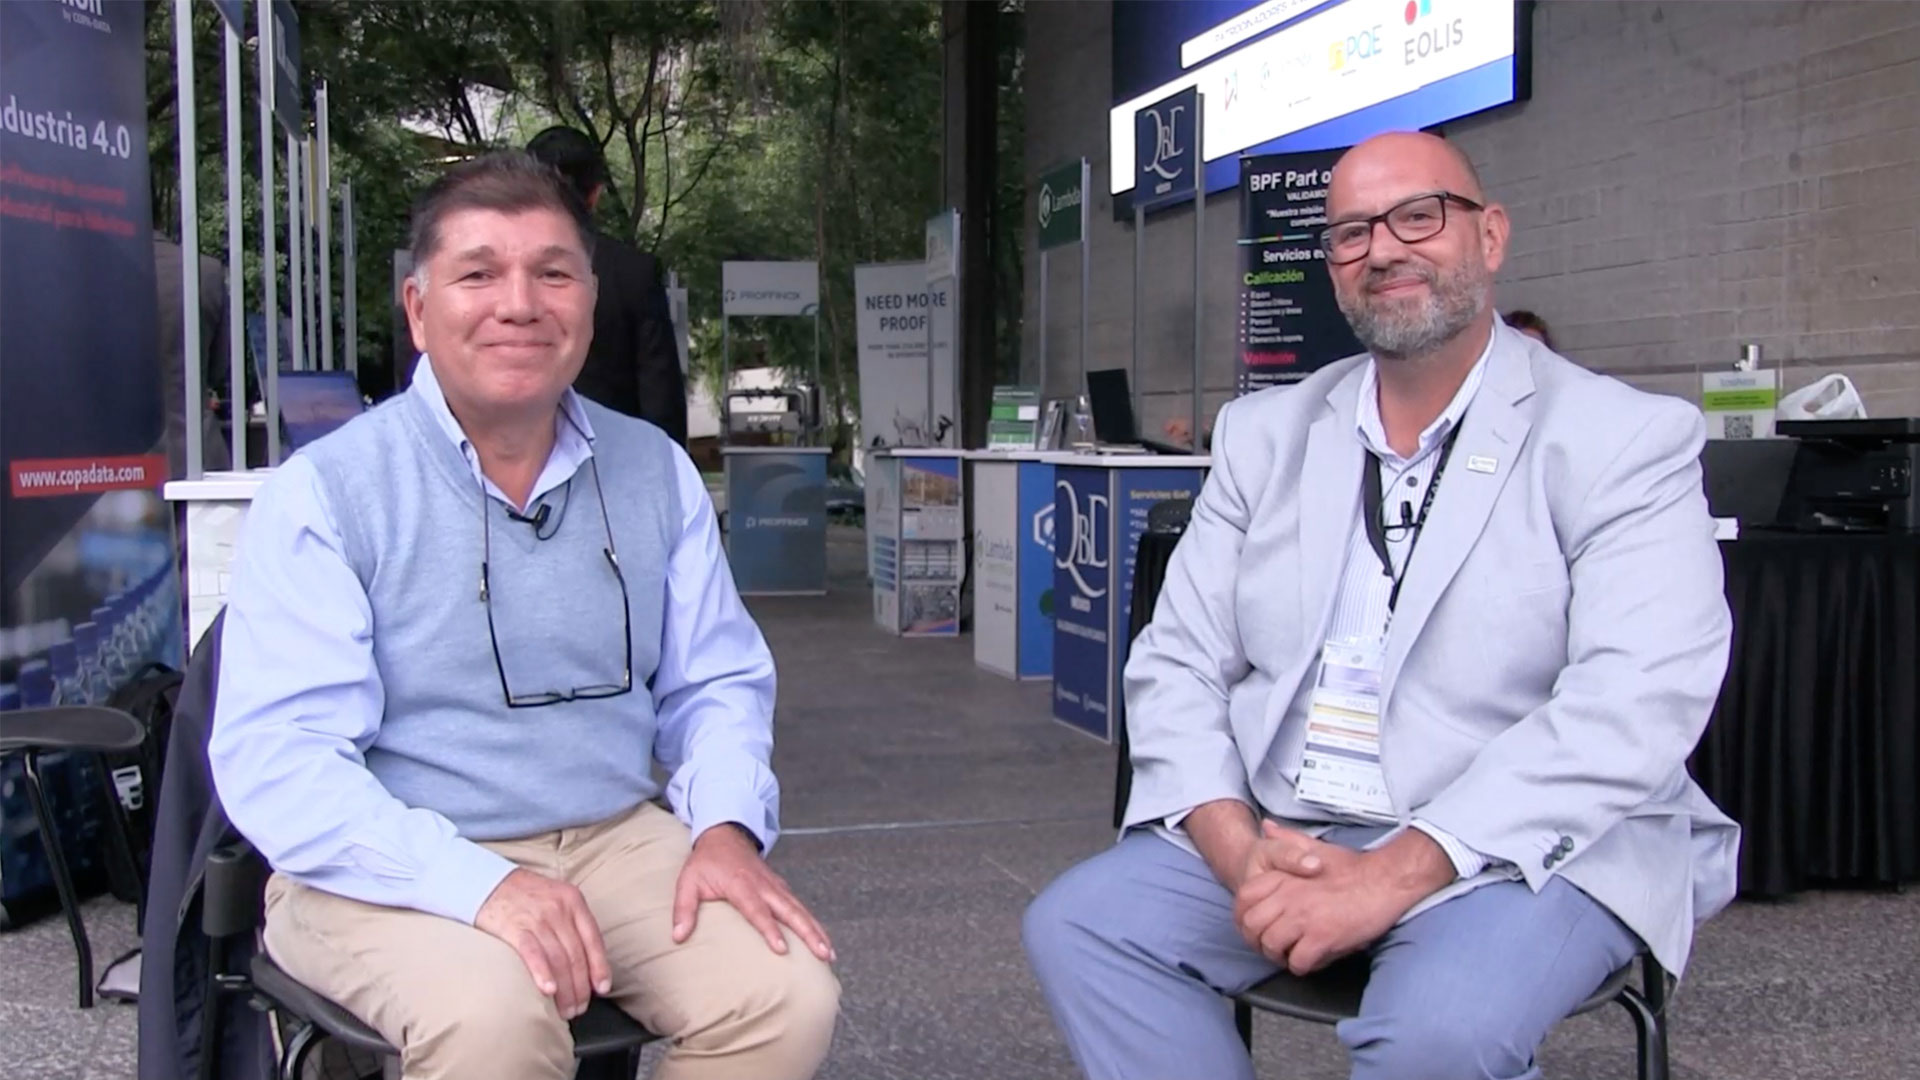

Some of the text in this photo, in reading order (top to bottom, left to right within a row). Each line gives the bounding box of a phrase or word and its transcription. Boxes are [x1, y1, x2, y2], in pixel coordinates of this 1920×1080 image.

[1404, 18, 1464, 66] EOLIS
[0, 94, 131, 159] dustria 4.0
[1249, 172, 1283, 192] BPF
[1285, 169, 1319, 188] Part
[1286, 188, 1329, 202] VALIDAMO
[1262, 248, 1312, 263] Servicios
[866, 291, 947, 311] NEED MORE
[880, 315, 928, 332] PROOF
[19, 462, 145, 491] www.copadata.com
